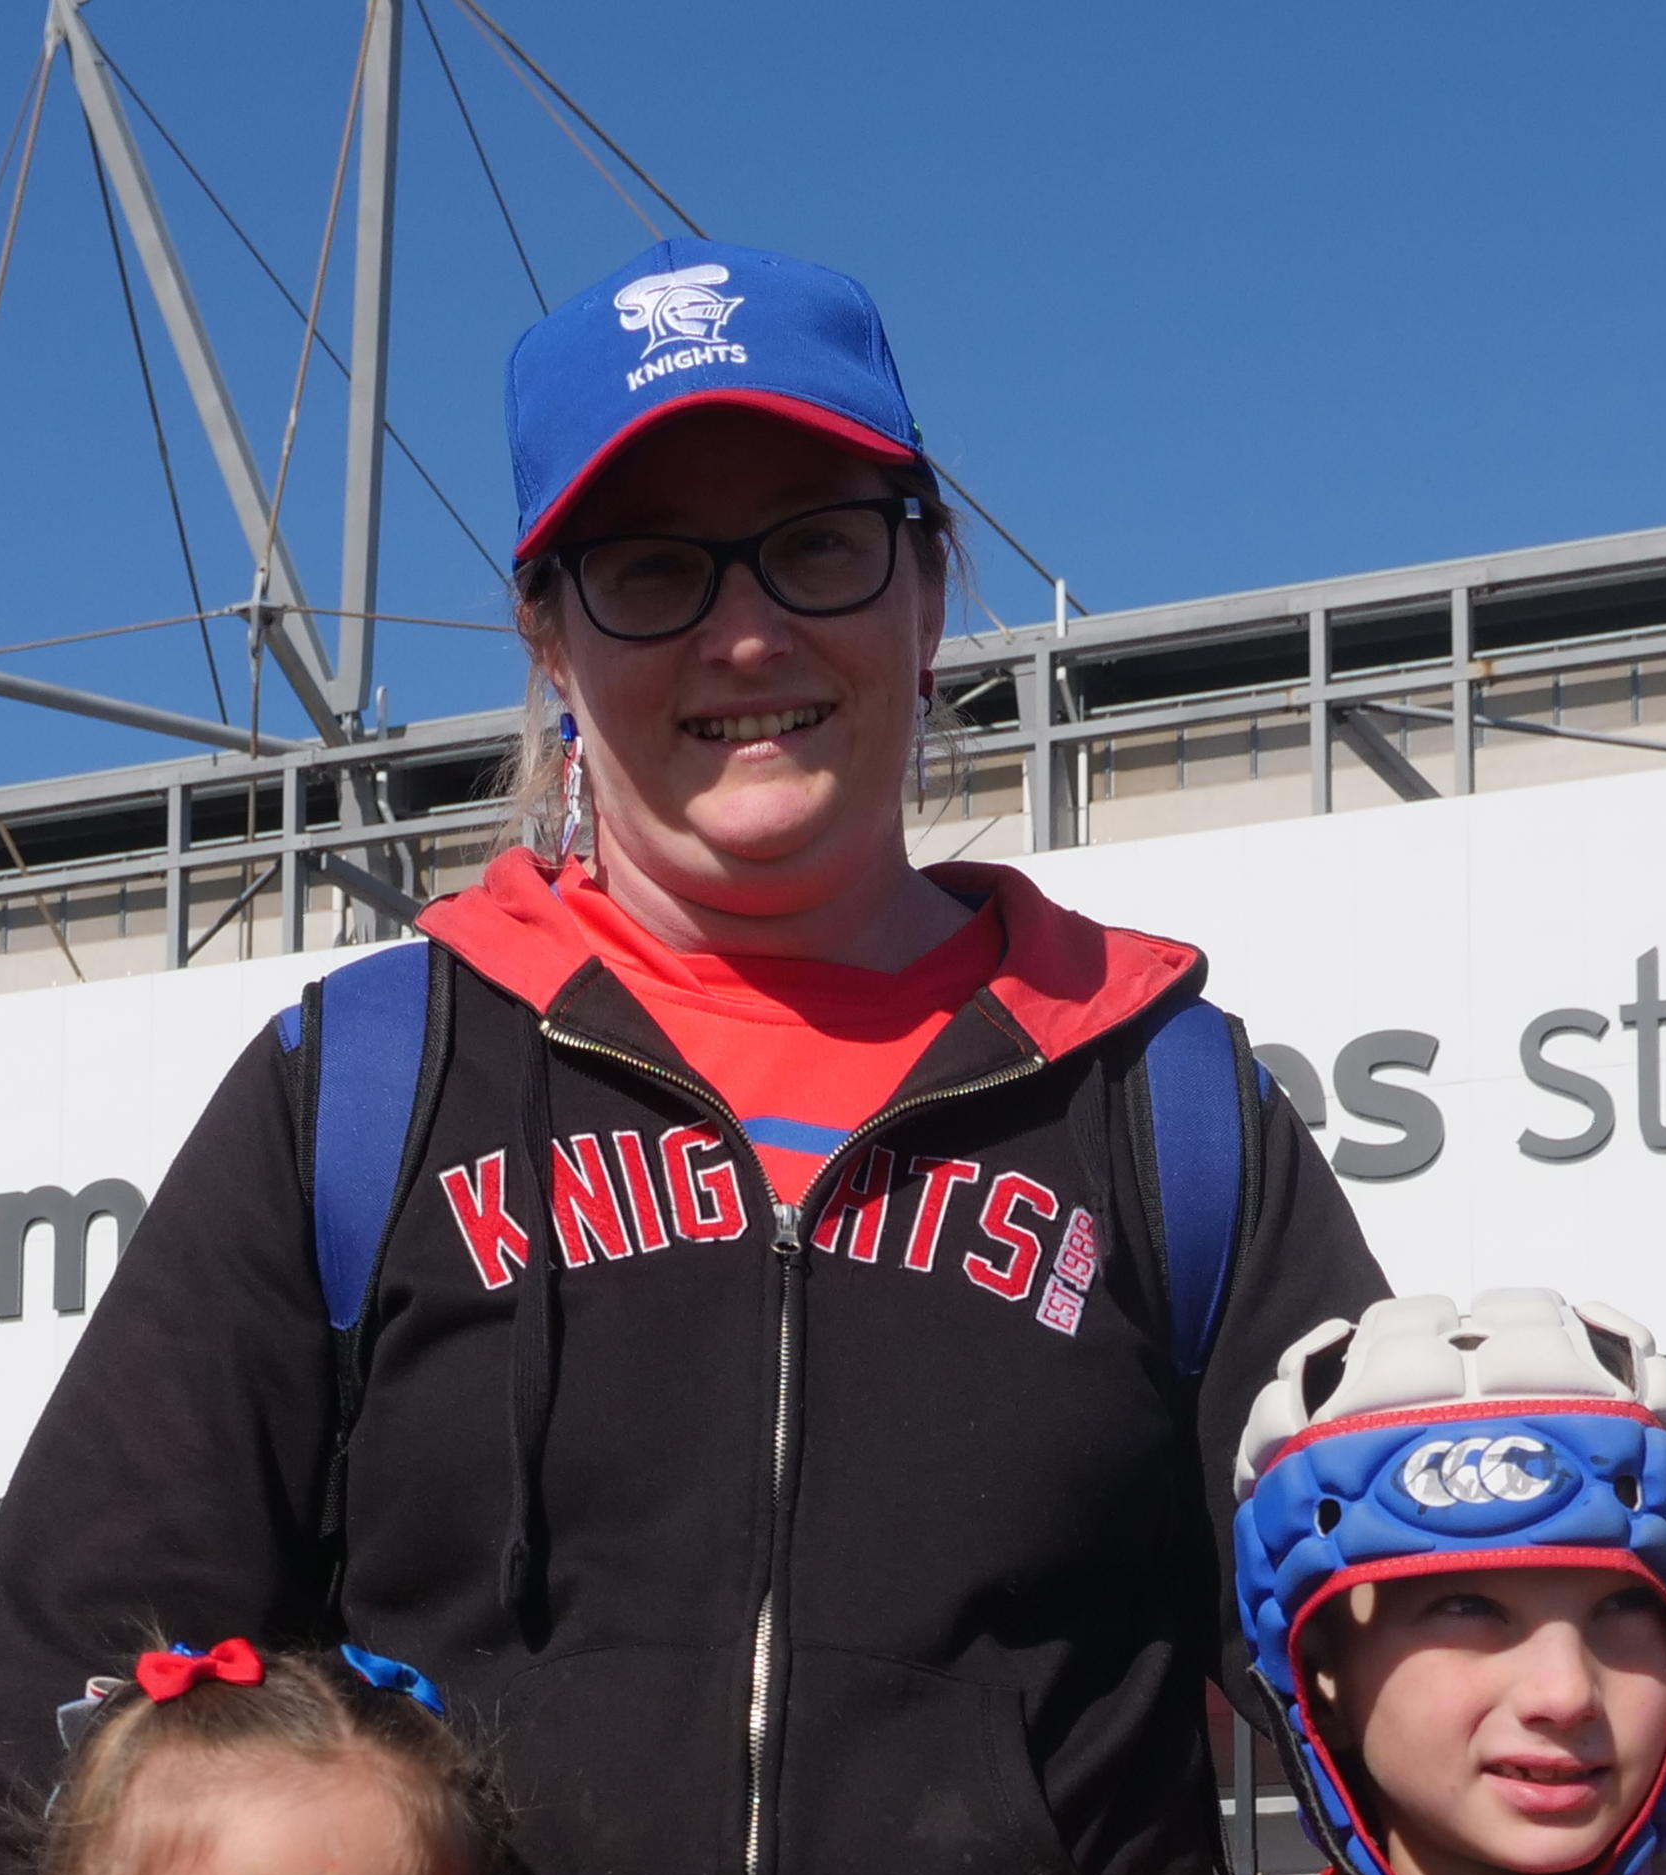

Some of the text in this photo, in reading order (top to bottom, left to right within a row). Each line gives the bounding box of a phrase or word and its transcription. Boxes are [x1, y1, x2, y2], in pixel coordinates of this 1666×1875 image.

[626, 343, 748, 392] KNIGHTS
[438, 1120, 1059, 1301] KNIGHTS
[1040, 1280, 1082, 1333] EST
